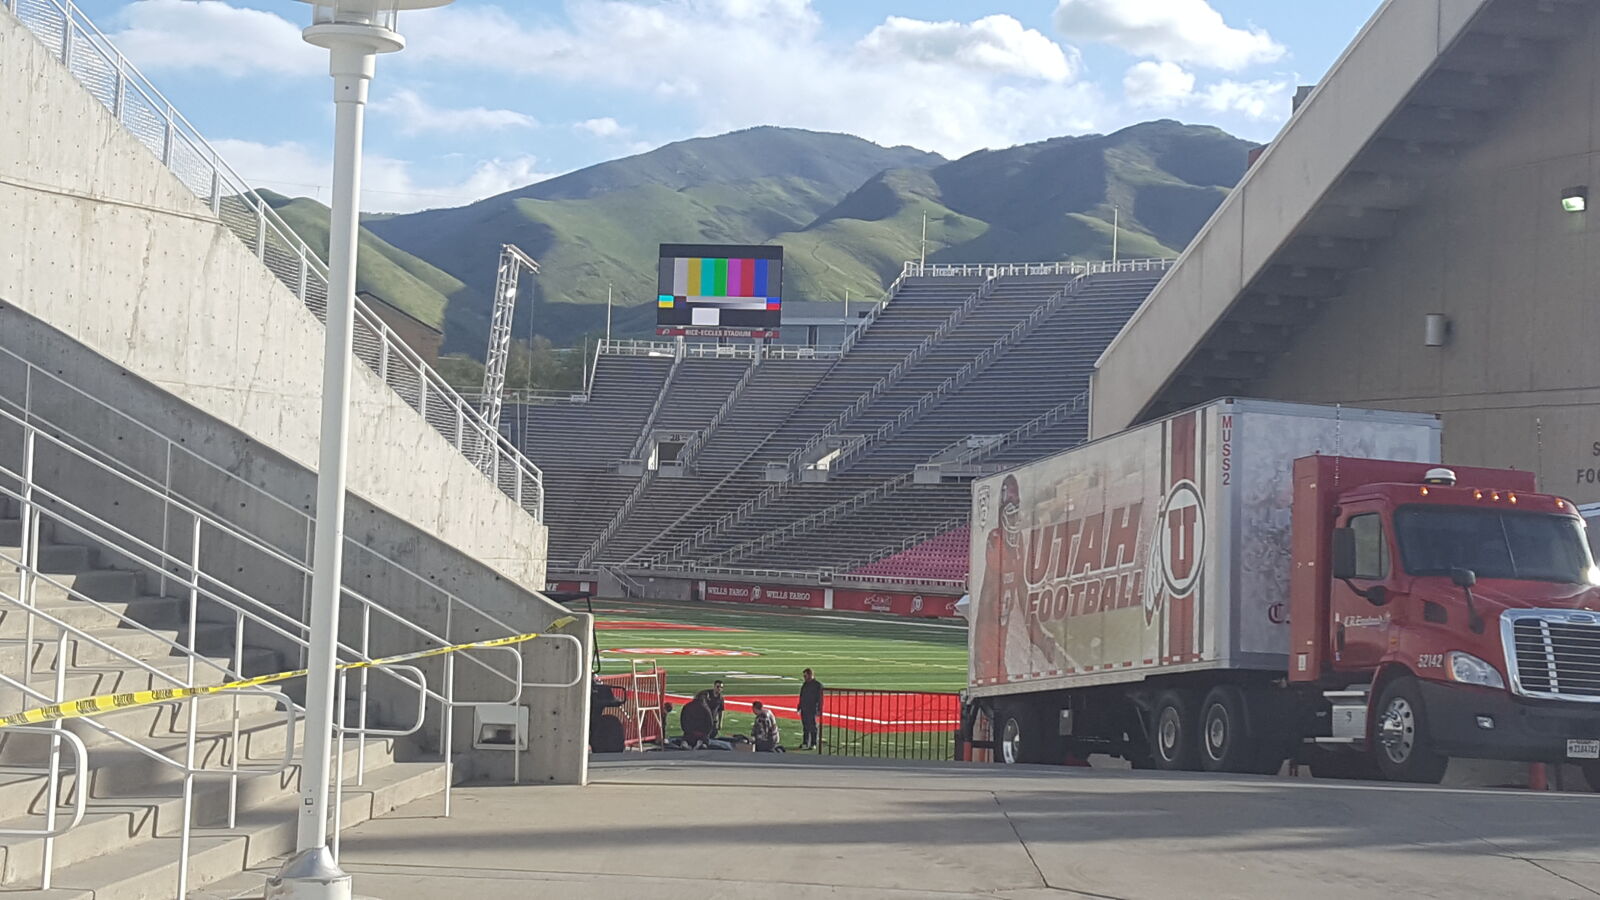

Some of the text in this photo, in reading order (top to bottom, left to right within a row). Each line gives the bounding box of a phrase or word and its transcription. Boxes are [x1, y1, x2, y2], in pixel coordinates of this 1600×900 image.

[1023, 501, 1143, 587] UTAH
[1168, 505, 1197, 580] U
[707, 586, 749, 597] WELLS FARGO
[766, 590, 811, 601] WELLS FARGO
[1025, 569, 1144, 627] FOOTBALL
[1418, 654, 1443, 668] 52142
